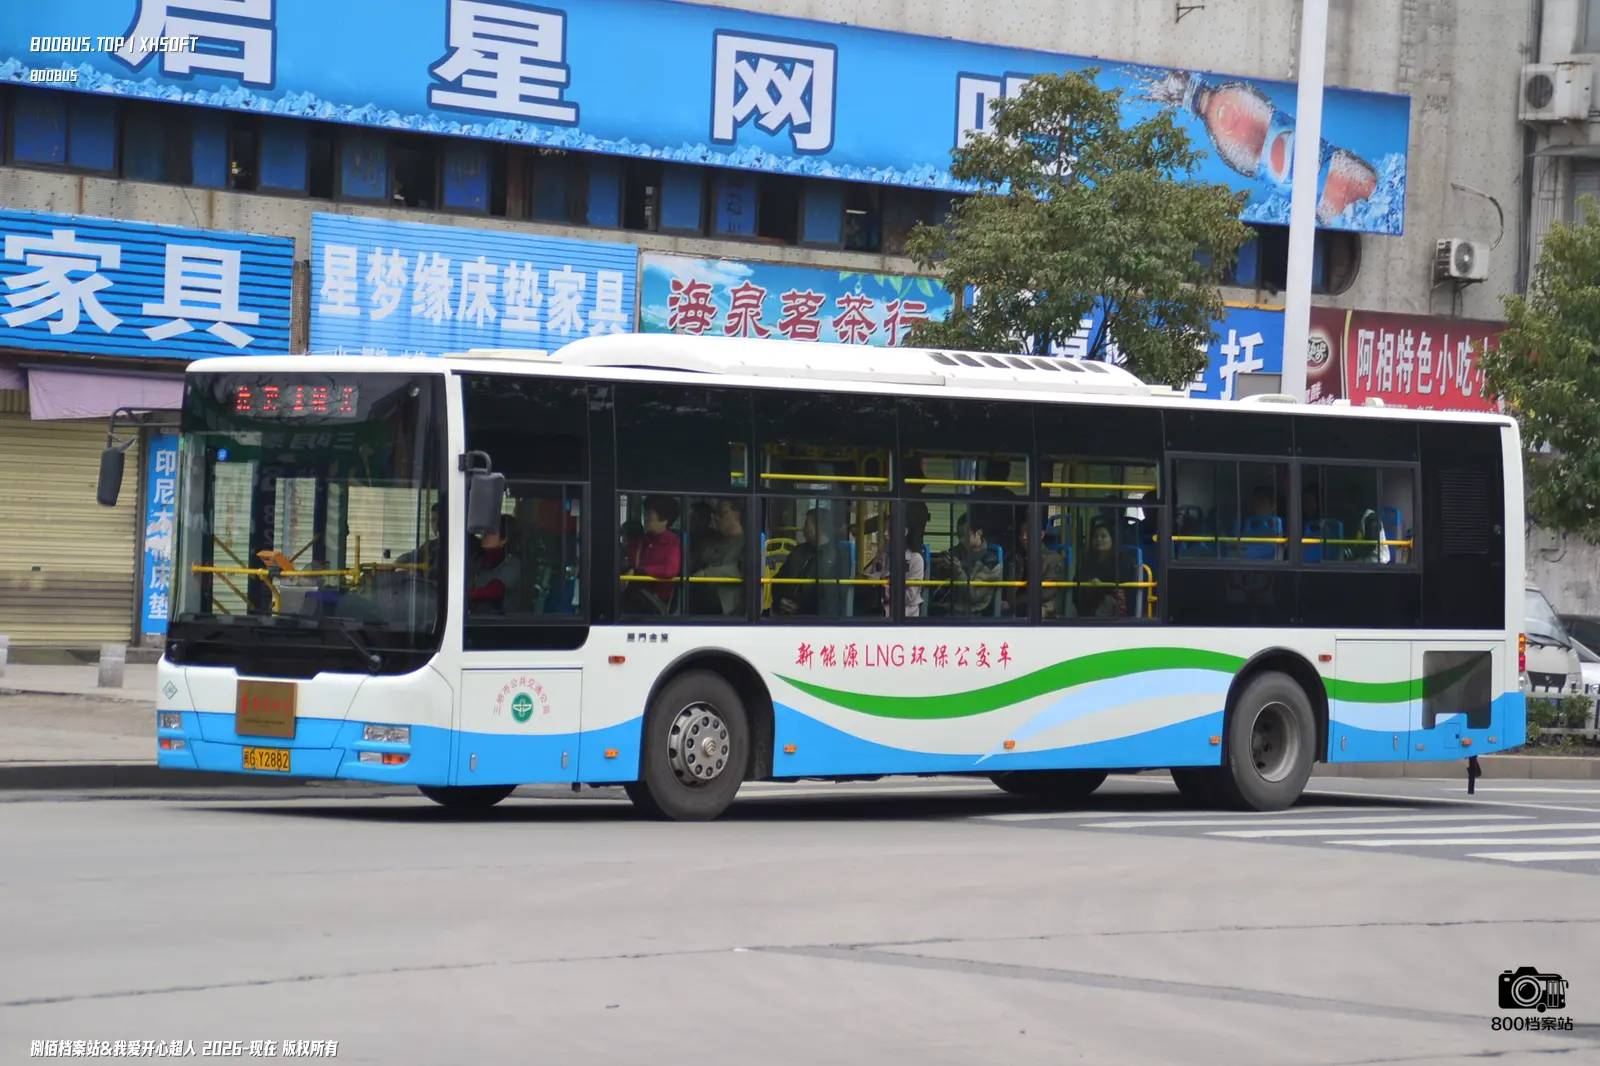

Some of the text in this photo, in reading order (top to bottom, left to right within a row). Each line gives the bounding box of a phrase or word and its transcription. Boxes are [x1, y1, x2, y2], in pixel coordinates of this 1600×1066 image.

[1, 229, 260, 350] 家具
[318, 244, 629, 336] 星梦缘床垫家具
[666, 277, 930, 347] 海泉茗茶行
[146, 449, 177, 620] 印尼床垫
[795, 641, 1013, 671] 新能源LNG环保公交车
